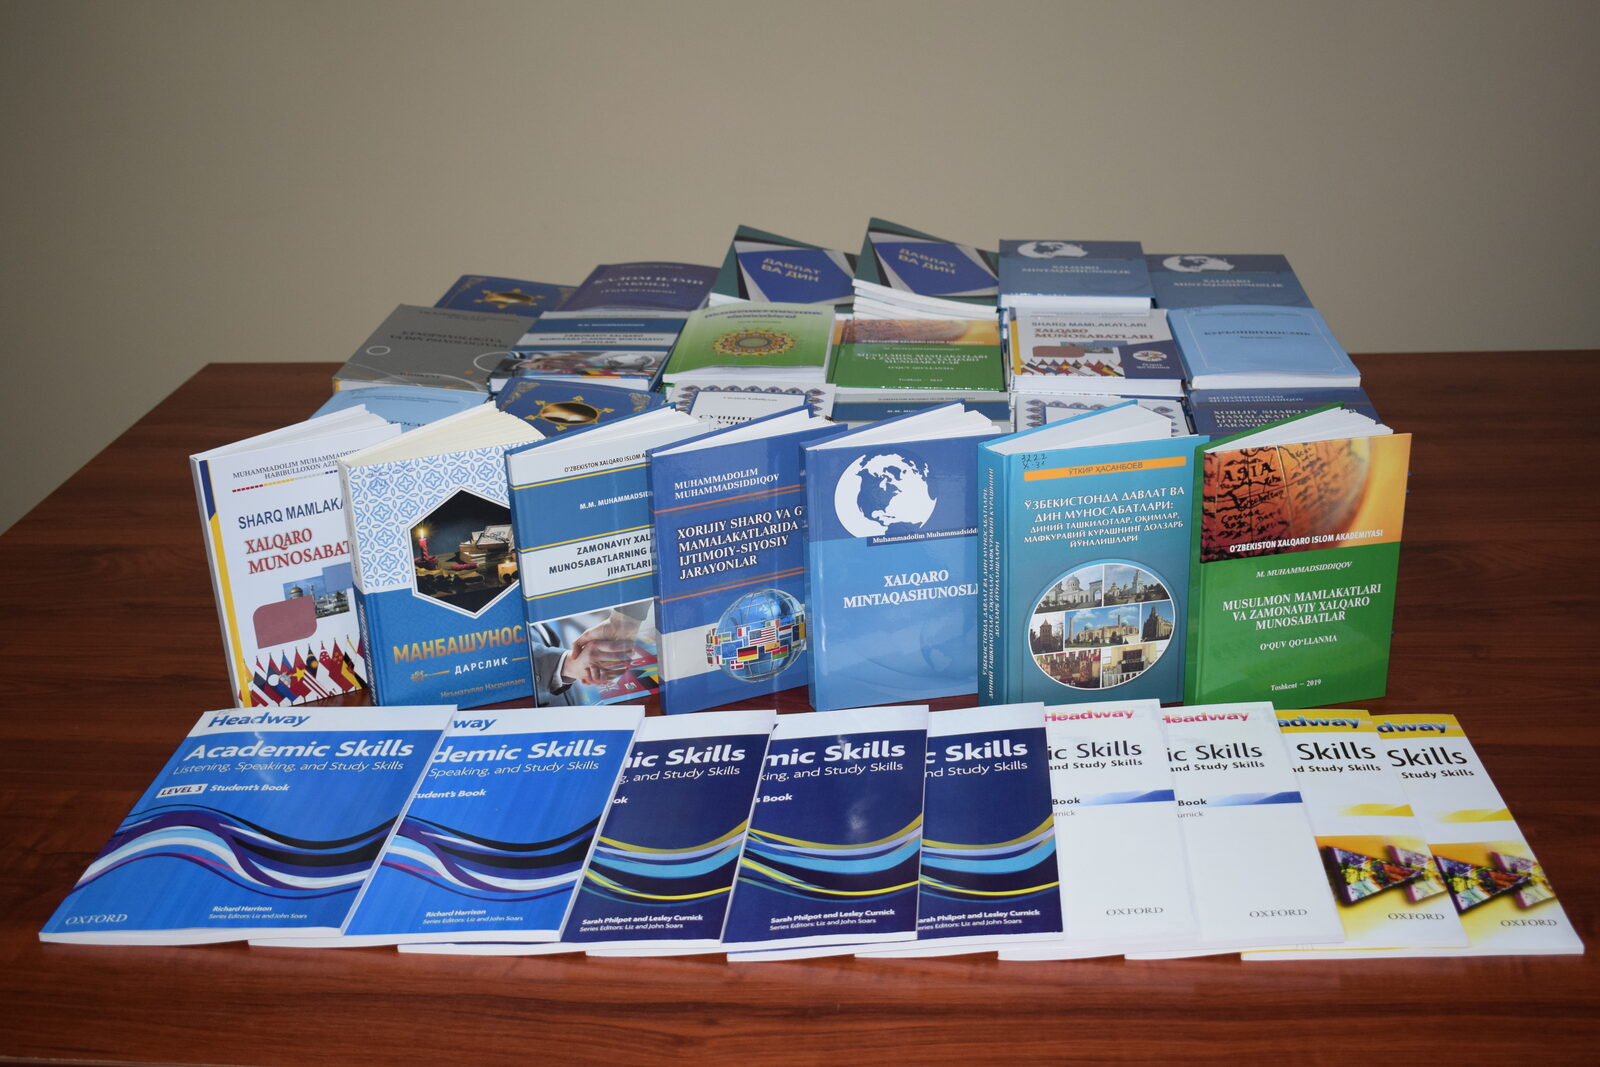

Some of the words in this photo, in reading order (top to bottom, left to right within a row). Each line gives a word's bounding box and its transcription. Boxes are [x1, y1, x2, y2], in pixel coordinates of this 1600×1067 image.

[763, 258, 820, 275] ДАВЛАТ
[898, 254, 918, 266] ВА
[922, 262, 956, 275] ДИН
[900, 248, 956, 268] ДАВЛАТ
[761, 264, 782, 274] ВА
[785, 270, 819, 283] ДИН
[232, 460, 298, 479] MUHAMMADOLIM
[264, 462, 321, 480] HABIBULLOXON
[564, 461, 598, 472] O'ZBEKISTON
[599, 456, 624, 468] XALQARO
[624, 453, 640, 462] ISLOM
[674, 468, 758, 490] MUHAMMADOLIM
[675, 474, 780, 500] MUHAMMADSIDDIQOV
[580, 500, 596, 510] M.M.
[1024, 492, 1118, 510] ЎЗБЕКИСТОНДА
[1122, 488, 1166, 501] ДАВЛАТ
[1170, 486, 1185, 496] ВА
[238, 508, 283, 530] SHARQ
[1034, 512, 1062, 523] ДИН
[1064, 501, 1174, 520] МУНОСАБАТЛАРИ:
[678, 520, 727, 540] XORIJIY
[730, 512, 772, 529] SHARQ
[776, 508, 790, 520] VA
[1024, 530, 1086, 544] МАФКУРАВИЙ
[1088, 525, 1142, 538] КУРАШНИНГ
[1144, 520, 1184, 532] ДОЛЗАРБ
[1030, 522, 1063, 534] ДИНИЙ
[244, 528, 312, 555] XALQARO
[678, 520, 798, 552] MAMALAKATLARIDA
[872, 534, 925, 544] Muhammadolim
[1070, 534, 1138, 548] ЙЎНАЛИШЛАРИ
[1230, 540, 1276, 553] O'ZBEKISTON
[1277, 535, 1310, 547] XALQARO
[1312, 533, 1334, 544] ISLOM
[1336, 529, 1384, 542] AKADEMIYASI
[577, 536, 631, 556] ZAMONAVIY
[679, 535, 789, 566] IJTIMOIY-SIYOSIY
[548, 547, 647, 574] MUNOSABATLARNING
[607, 559, 651, 576] JIHATLARI
[680, 555, 758, 580] JARAYONLAR
[1266, 561, 1352, 577] MUHAMMADSIDDIQOV
[884, 570, 948, 588] XALQARO
[1222, 594, 1291, 612] MUSULMON
[1294, 584, 1382, 603] MAMLAKATLARI
[1232, 611, 1247, 622] VA
[1250, 603, 1316, 620] ZAMONAVIY
[1319, 596, 1370, 612] XALQARO
[1256, 611, 1346, 631] MUNOSABATLAR
[393, 625, 527, 664] МАНБАШУНОС
[1260, 640, 1286, 651] O'QUV
[454, 656, 508, 676] ДАРСЛИК
[1306, 679, 1322, 687] 2019
[208, 712, 310, 728] Headway
[453, 718, 497, 731] way
[184, 740, 332, 761] Academic
[335, 738, 414, 758] Skills
[528, 739, 608, 760] Skills
[665, 744, 746, 766] Skills
[824, 740, 906, 762] Skills
[945, 739, 1028, 762] Skills
[1076, 740, 1142, 759] Skills
[1196, 742, 1262, 760] Skills
[1296, 742, 1376, 761] Skills
[1387, 746, 1468, 768] Skills
[172, 762, 232, 776] Listening,
[300, 760, 326, 772] and
[328, 760, 370, 772] Study
[372, 760, 405, 771] Skills
[494, 764, 520, 775] and
[523, 762, 564, 774] Study
[568, 760, 600, 771] Skills
[794, 768, 821, 778] and
[824, 764, 866, 776] Study
[870, 762, 904, 772] Skills
[948, 764, 990, 776] Study
[994, 760, 1028, 772] Skills
[1073, 761, 1106, 770] Study
[1111, 758, 1142, 766] Skills
[1194, 762, 1228, 771] Study
[633, 772, 660, 782] and
[662, 769, 704, 780] Study
[707, 766, 740, 776] Skills
[1402, 772, 1436, 780] Study
[1442, 769, 1475, 778] Skills
[160, 786, 194, 796] LEVEL
[210, 784, 260, 792] Student's
[262, 784, 290, 792] Book
[458, 788, 487, 798] Book
[763, 793, 792, 802] Book
[1052, 797, 1080, 805] Book
[1178, 798, 1207, 807] Book
[65, 913, 128, 926] OXFORD
[604, 916, 632, 924] Philpot
[793, 914, 822, 922] Philpot
[1106, 906, 1164, 916] OXFORD
[1249, 908, 1308, 918] OXFORD
[1388, 912, 1446, 921] OXFORD
[1500, 918, 1558, 928] OXFORD
